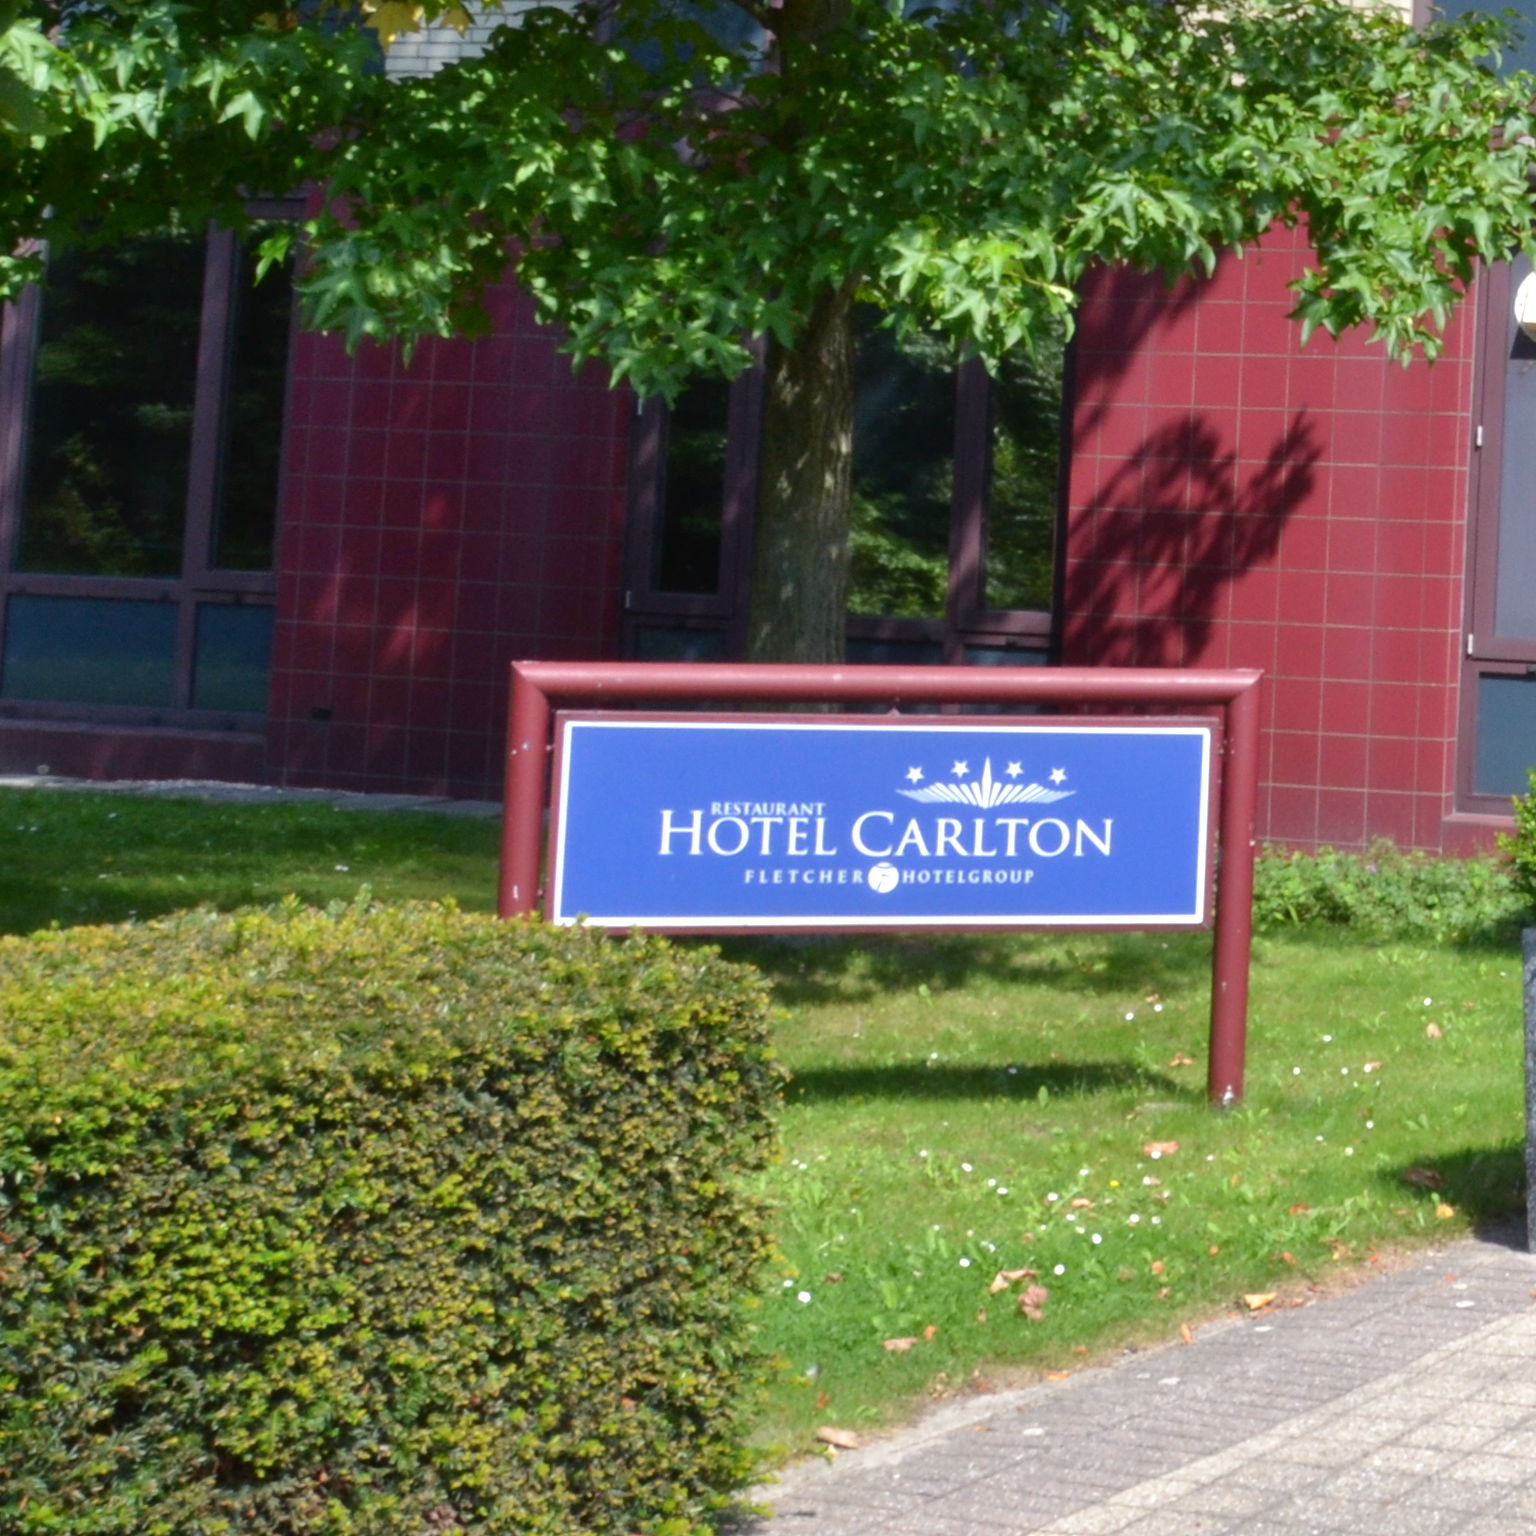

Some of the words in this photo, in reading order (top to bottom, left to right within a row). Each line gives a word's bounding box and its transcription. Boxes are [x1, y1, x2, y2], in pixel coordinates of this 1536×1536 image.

[711, 801, 826, 816] RESTAURANT
[658, 809, 837, 856] HOTEL
[851, 810, 1114, 858] CARLTON
[744, 868, 864, 885] FLETCHER
[901, 868, 1035, 885] HOTELGROUP
